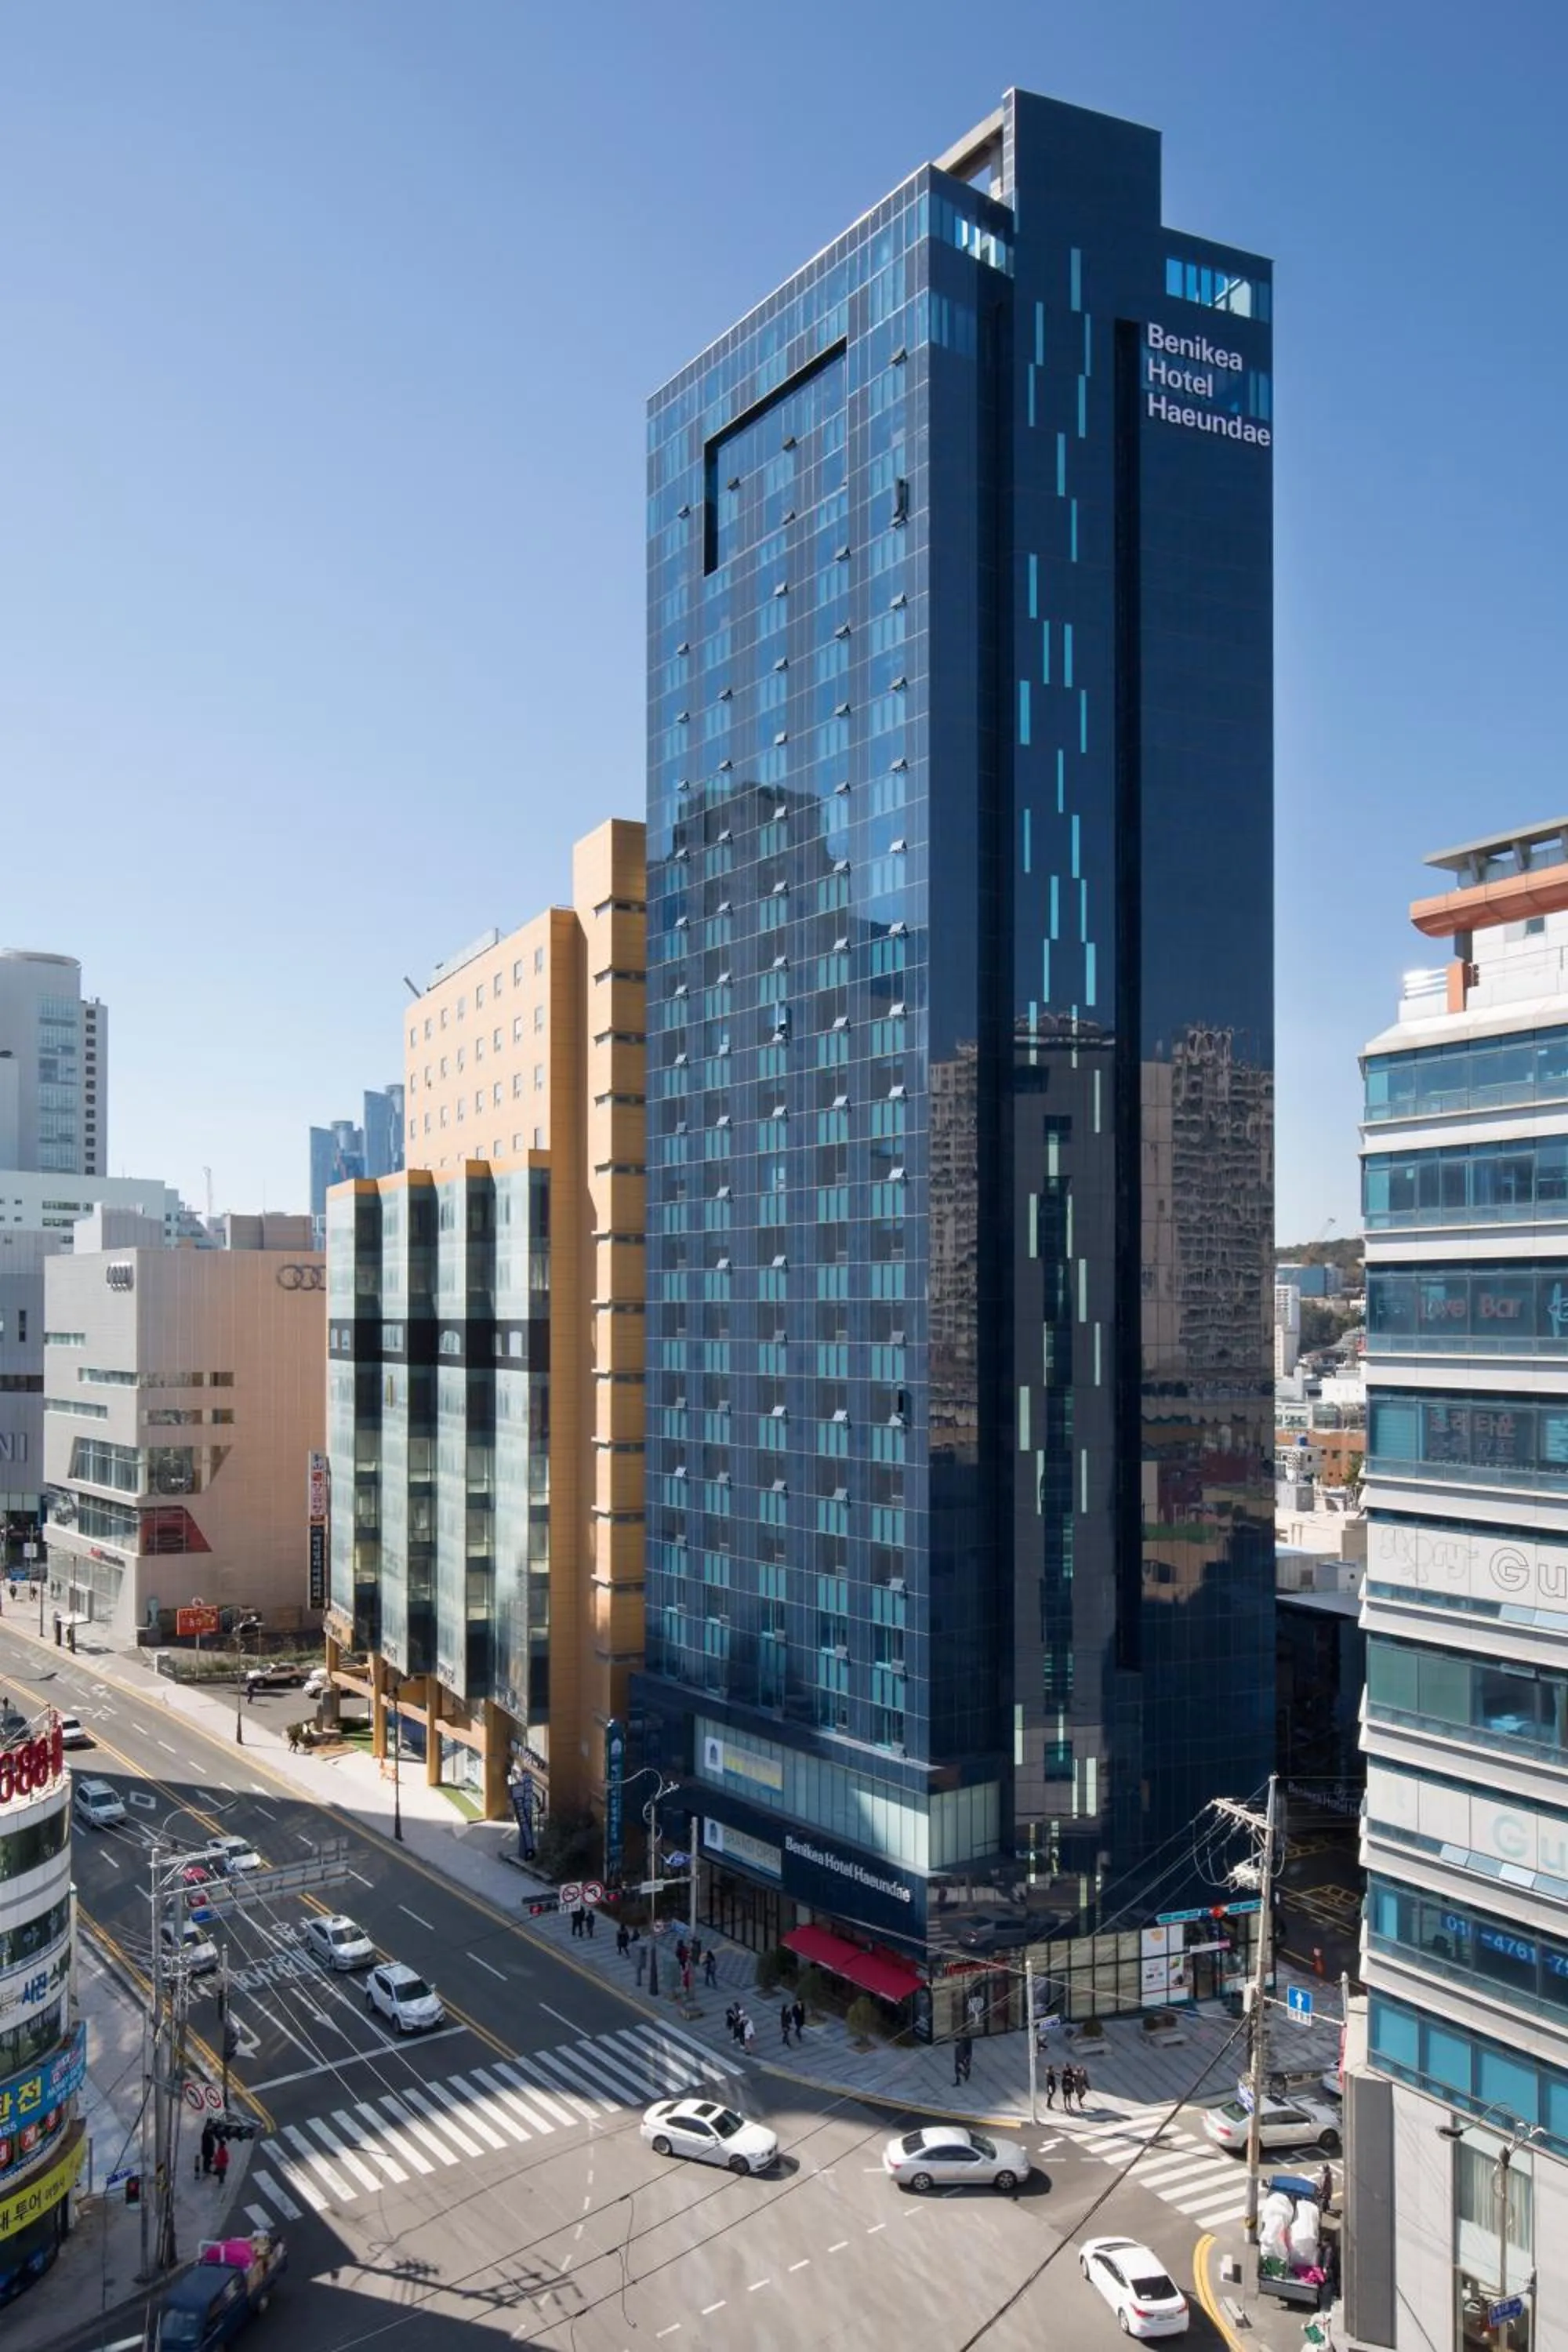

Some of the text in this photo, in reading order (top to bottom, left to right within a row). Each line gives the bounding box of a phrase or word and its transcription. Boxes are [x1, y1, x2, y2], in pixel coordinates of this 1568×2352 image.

[1147, 322, 1243, 371] Benikea
[1147, 358, 1213, 397] Hotel
[1147, 394, 1271, 446] Haeundae
[1490, 1547, 1567, 1599] Gu
[785, 1835, 910, 1903] Benikea Hotel Haeundae
